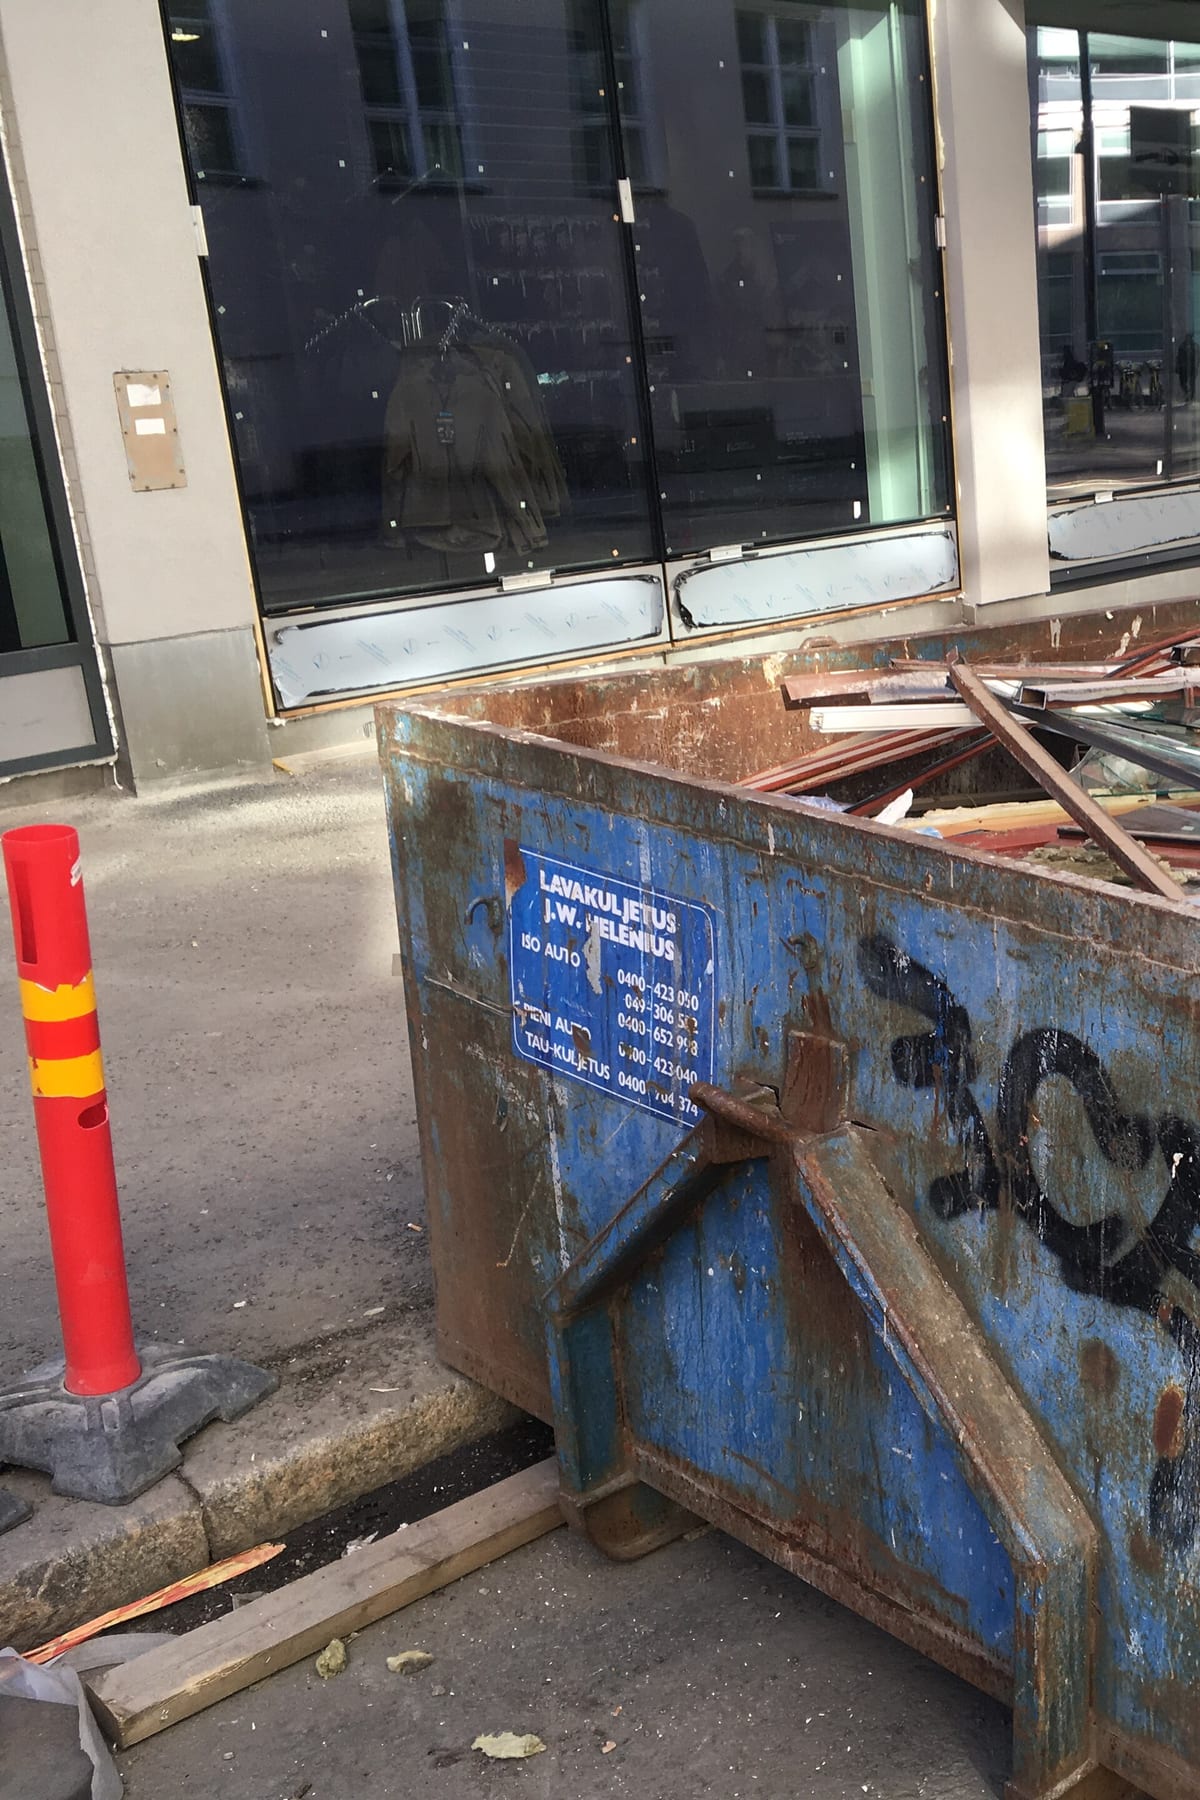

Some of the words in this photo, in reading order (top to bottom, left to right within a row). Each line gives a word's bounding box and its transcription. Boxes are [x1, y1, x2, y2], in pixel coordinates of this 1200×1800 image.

[540, 869, 676, 934] LAVAKULJETUS
[543, 898, 582, 929] J.W.
[521, 932, 541, 953] ISO
[678, 1095, 699, 1117] 374
